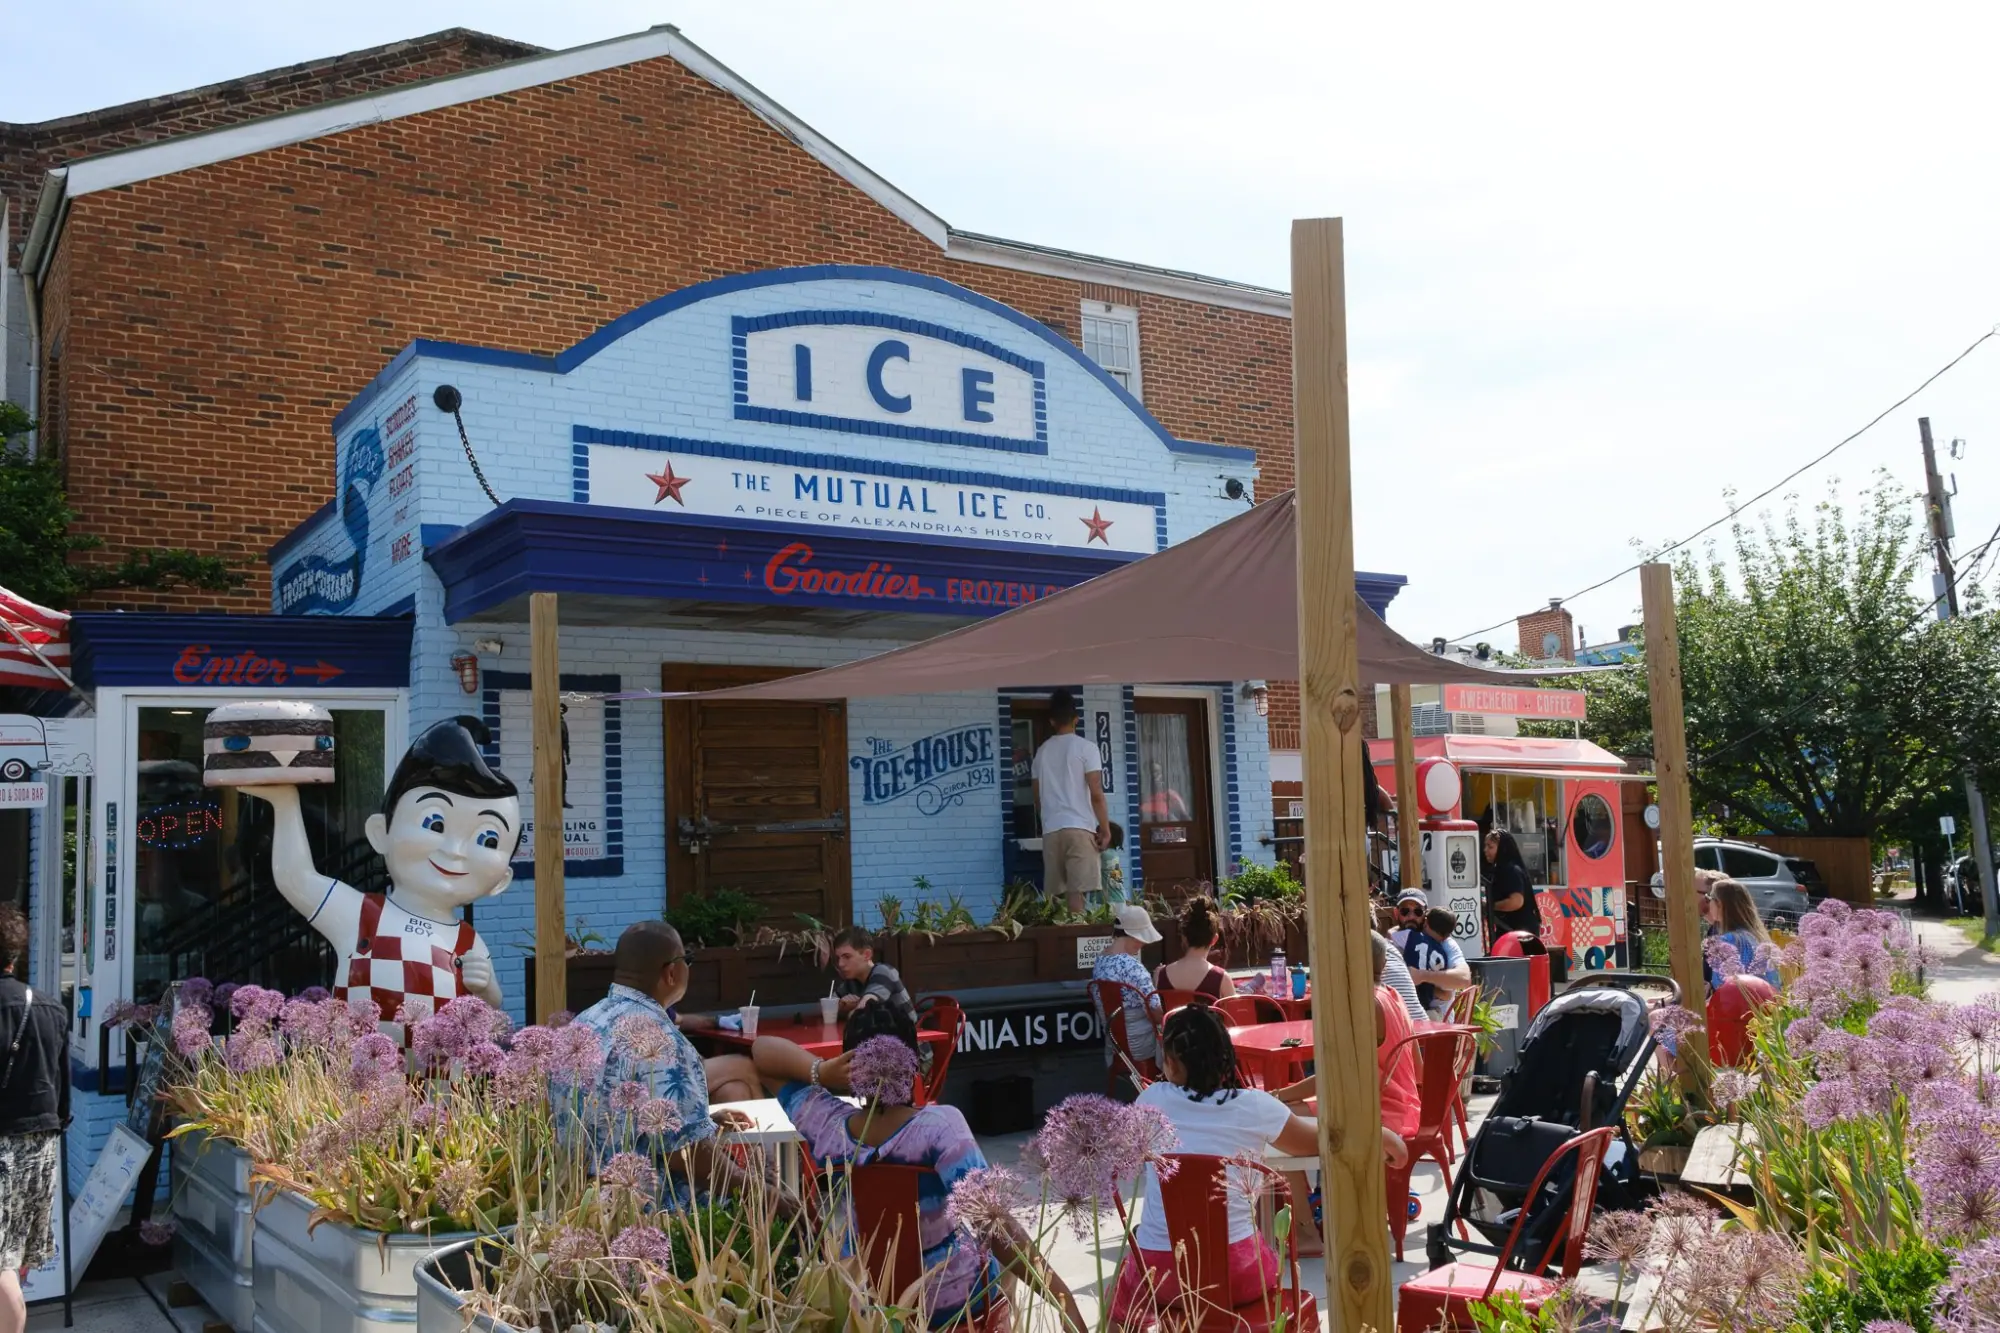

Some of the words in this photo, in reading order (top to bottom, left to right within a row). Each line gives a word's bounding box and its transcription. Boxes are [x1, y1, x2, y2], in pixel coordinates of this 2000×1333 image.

[795, 340, 994, 424] ICE
[731, 472, 771, 492] THE
[794, 473, 937, 513] MUTUAL
[958, 490, 1008, 520] ICE
[1024, 503, 1051, 520] CO.
[734, 504, 746, 513] A
[755, 506, 809, 520] PIECE
[818, 512, 842, 522] OF
[850, 516, 978, 535] ALEXANDRIA'S
[985, 528, 1053, 541] HISTORY
[764, 543, 935, 599] Goodies
[946, 578, 1037, 607] FROZEN
[173, 644, 289, 685] Enter
[1536, 694, 1573, 714] COFFEE
[866, 736, 893, 756] THE
[850, 755, 908, 802] ICE
[904, 728, 995, 785] HOUSE
[943, 783, 968, 796] CIRCA
[967, 768, 995, 788] 1931
[31, 787, 44, 801] BAR
[137, 807, 224, 842] OPEN
[565, 821, 597, 831] LING
[564, 833, 590, 843] UAL
[1453, 902, 1474, 910] ROUTE
[404, 924, 434, 938] BOY
[409, 917, 433, 930] BIG
[1454, 913, 1475, 935] 66
[1079, 952, 1098, 960] BEIG
[956, 1017, 1020, 1053] INIA
[1025, 1015, 1048, 1046] IS
